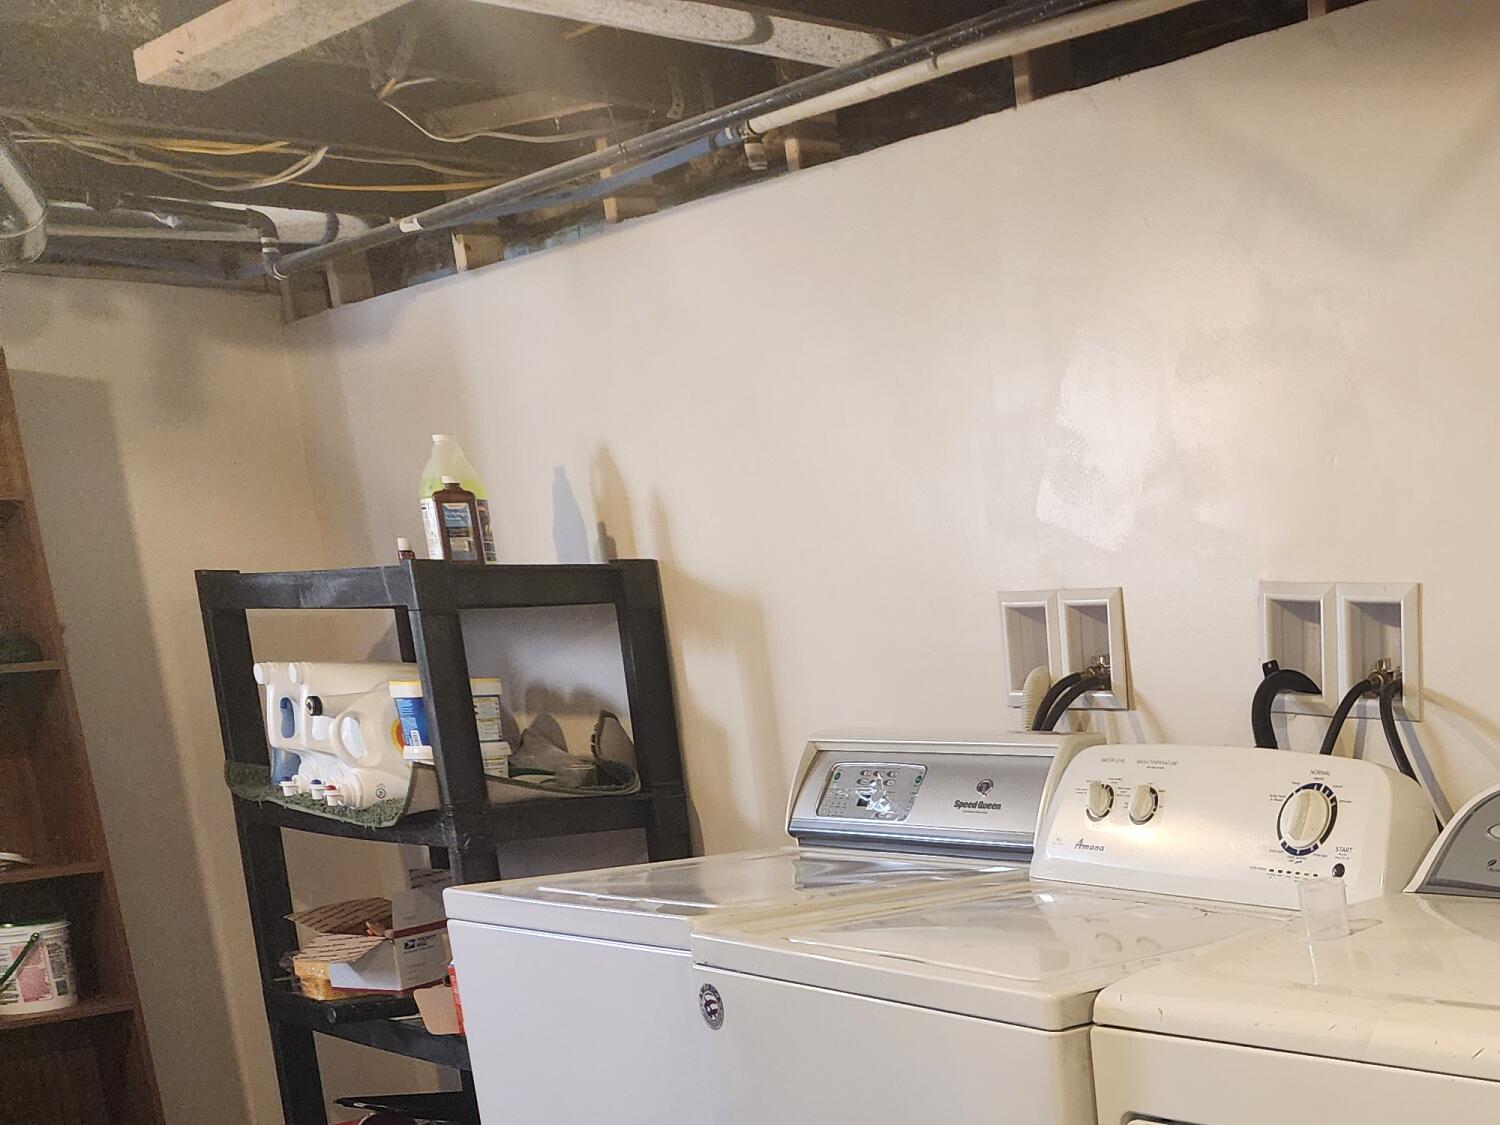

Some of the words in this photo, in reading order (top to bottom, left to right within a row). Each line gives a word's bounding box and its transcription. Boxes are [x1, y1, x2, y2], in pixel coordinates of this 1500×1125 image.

[953, 799, 978, 810] Speed
[978, 800, 1002, 810] Queen
[1073, 838, 1105, 852] Amana
